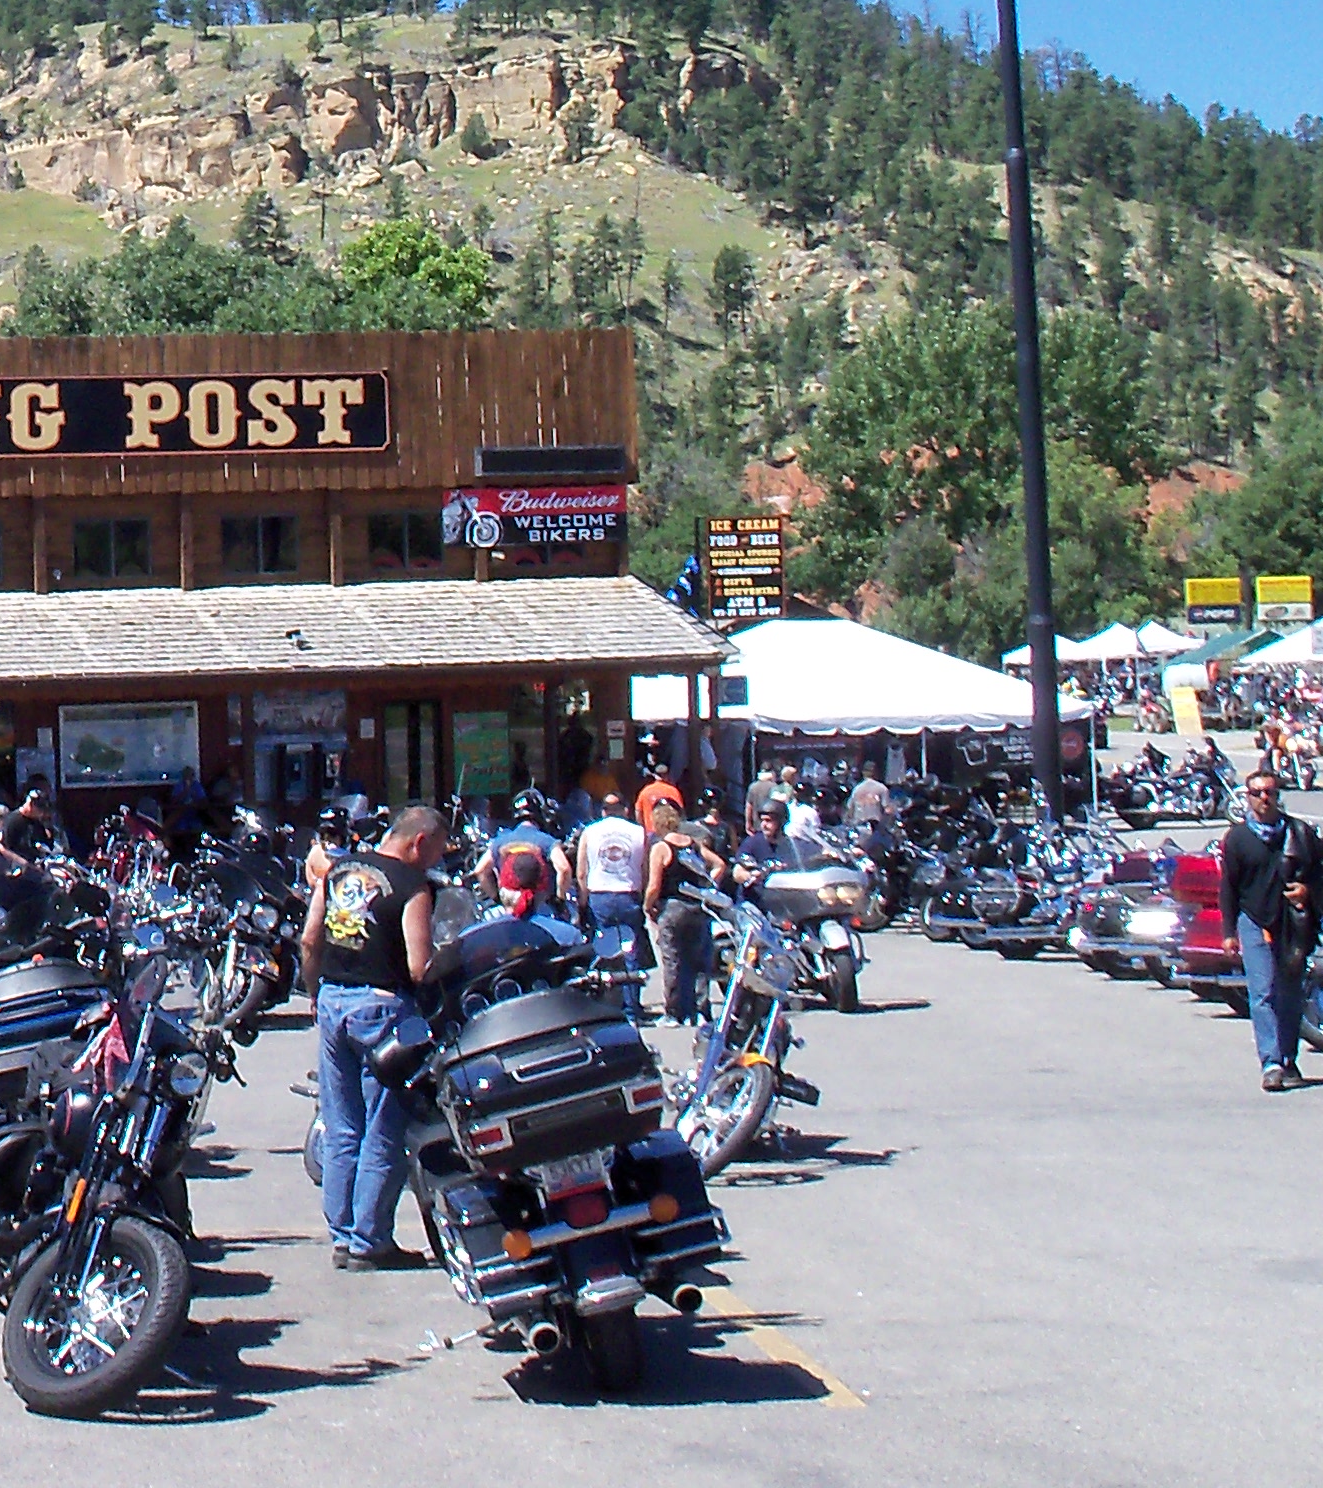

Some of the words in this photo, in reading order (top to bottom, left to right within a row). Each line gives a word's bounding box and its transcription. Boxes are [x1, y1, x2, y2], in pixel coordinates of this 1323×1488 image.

[122, 377, 365, 449] POST
[498, 489, 620, 513] Budweiser
[513, 514, 618, 529] WELCOME
[710, 520, 732, 532] ICE
[737, 519, 780, 531] CREAM
[528, 528, 606, 543] BIKERS
[709, 534, 738, 547] FOOD
[749, 533, 780, 546] BEER
[726, 596, 755, 607] ATM
